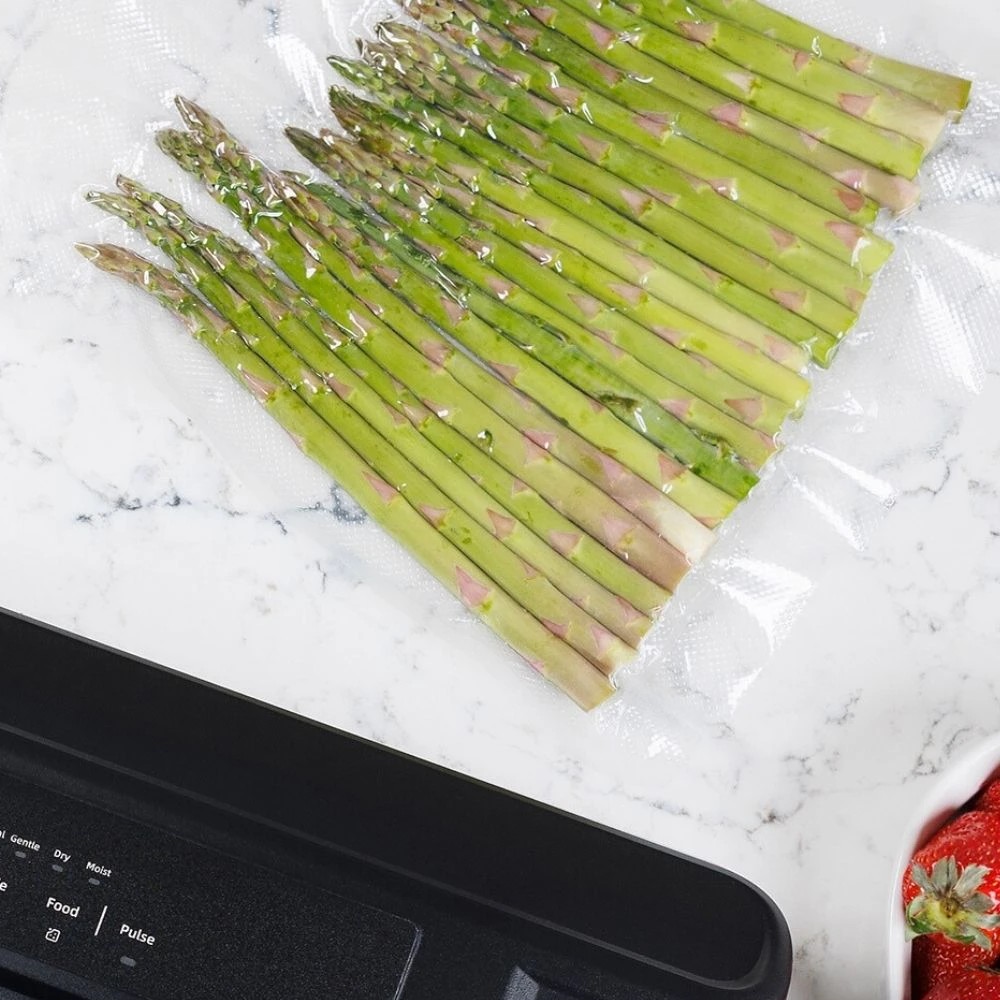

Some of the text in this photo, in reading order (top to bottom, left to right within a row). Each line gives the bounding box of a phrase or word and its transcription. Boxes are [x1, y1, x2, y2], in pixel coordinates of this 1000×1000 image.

[10, 834, 41, 851] Gentle
[53, 849, 71, 863] Dry
[86, 861, 112, 877] Moist
[46, 897, 80, 918] Food
[119, 924, 156, 946] Pulse
